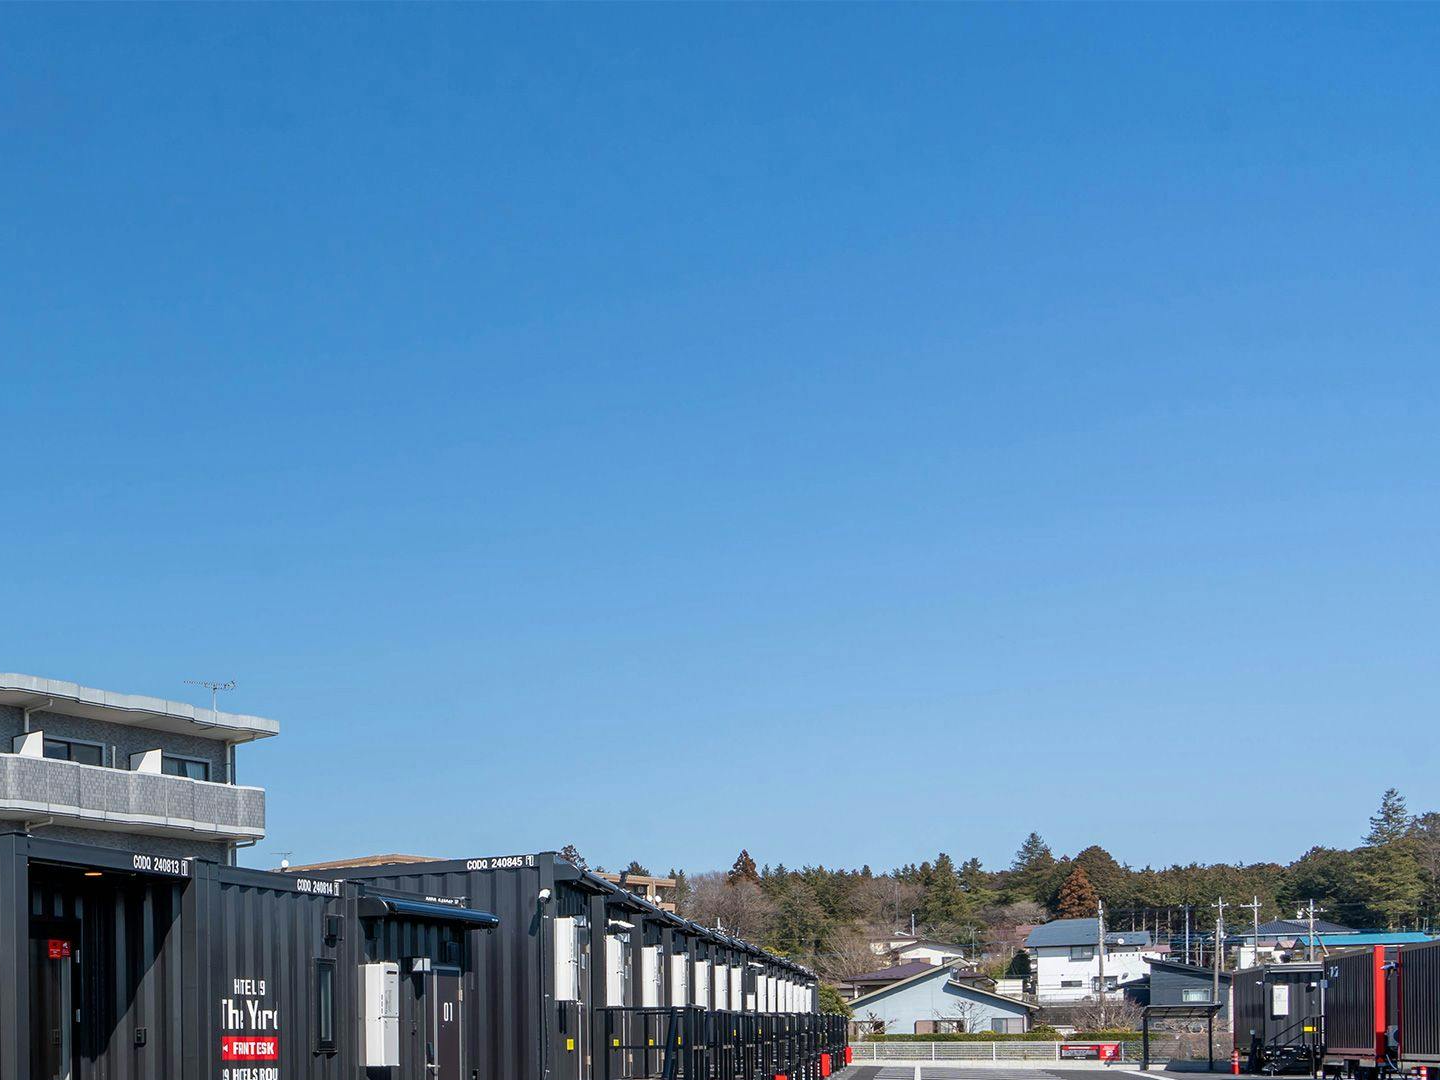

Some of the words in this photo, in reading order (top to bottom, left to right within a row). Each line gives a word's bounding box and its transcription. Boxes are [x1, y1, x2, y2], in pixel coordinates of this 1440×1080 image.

[133, 854, 151, 870] CODQ
[153, 857, 179, 874] 240813
[466, 859, 488, 870] CODQ
[233, 978, 257, 996] HTEL
[443, 1002, 453, 1022] 01
